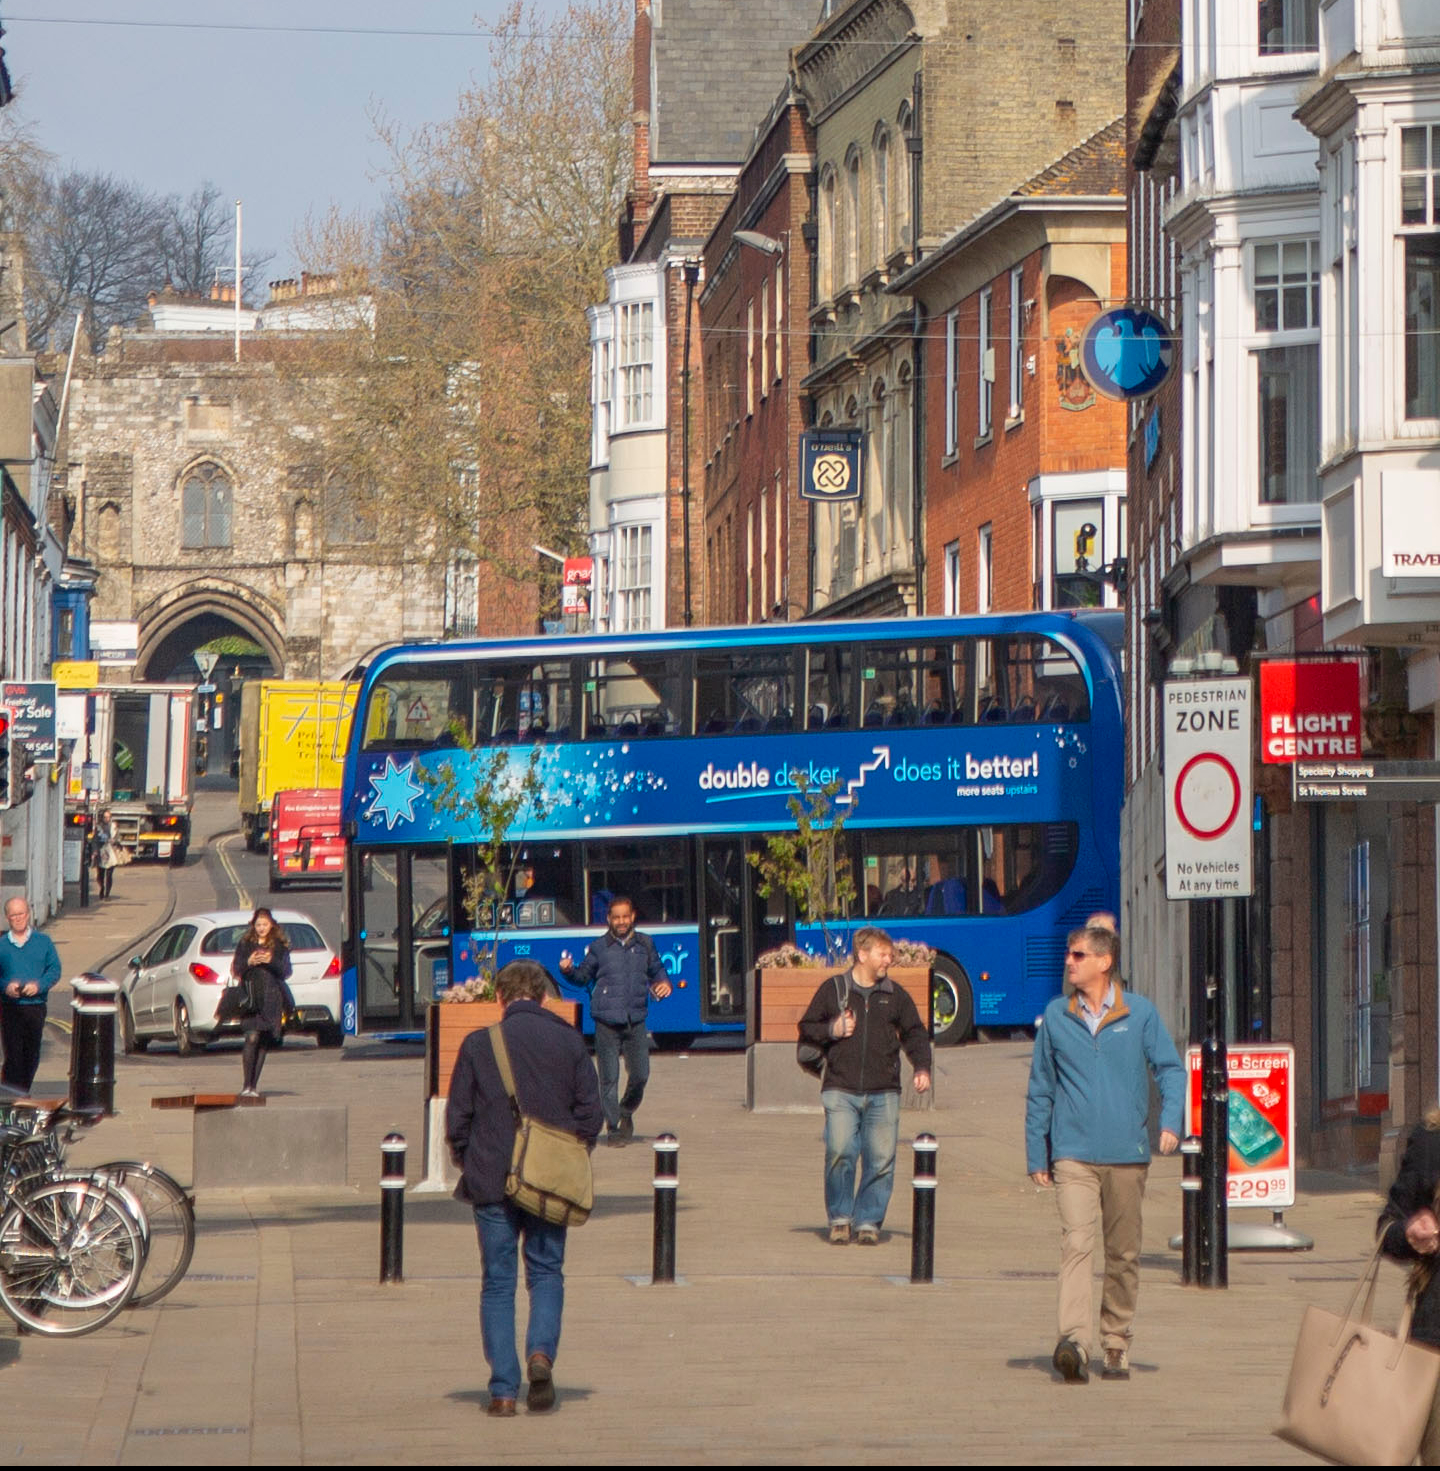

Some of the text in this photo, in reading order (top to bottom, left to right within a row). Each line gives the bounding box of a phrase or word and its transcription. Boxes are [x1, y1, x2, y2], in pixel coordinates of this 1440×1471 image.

[1168, 688, 1247, 705] PEDESTRIAN
[27, 705, 53, 719] Sale
[1176, 709, 1241, 732] ZONE
[1270, 714, 1353, 734] FLIGHT
[1268, 737, 1358, 756] CENTRE
[698, 761, 770, 791] double
[893, 757, 942, 783] does
[947, 755, 961, 780] it
[965, 751, 1040, 779] better!
[1337, 765, 1374, 778] Shopping
[956, 783, 1038, 797] more seats upstairs
[1309, 785, 1340, 796] Thomas
[1341, 785, 1367, 796] Street
[1177, 861, 1240, 875] No Vehicles
[1178, 878, 1240, 893] At any time
[1241, 1056, 1289, 1070] Screen
